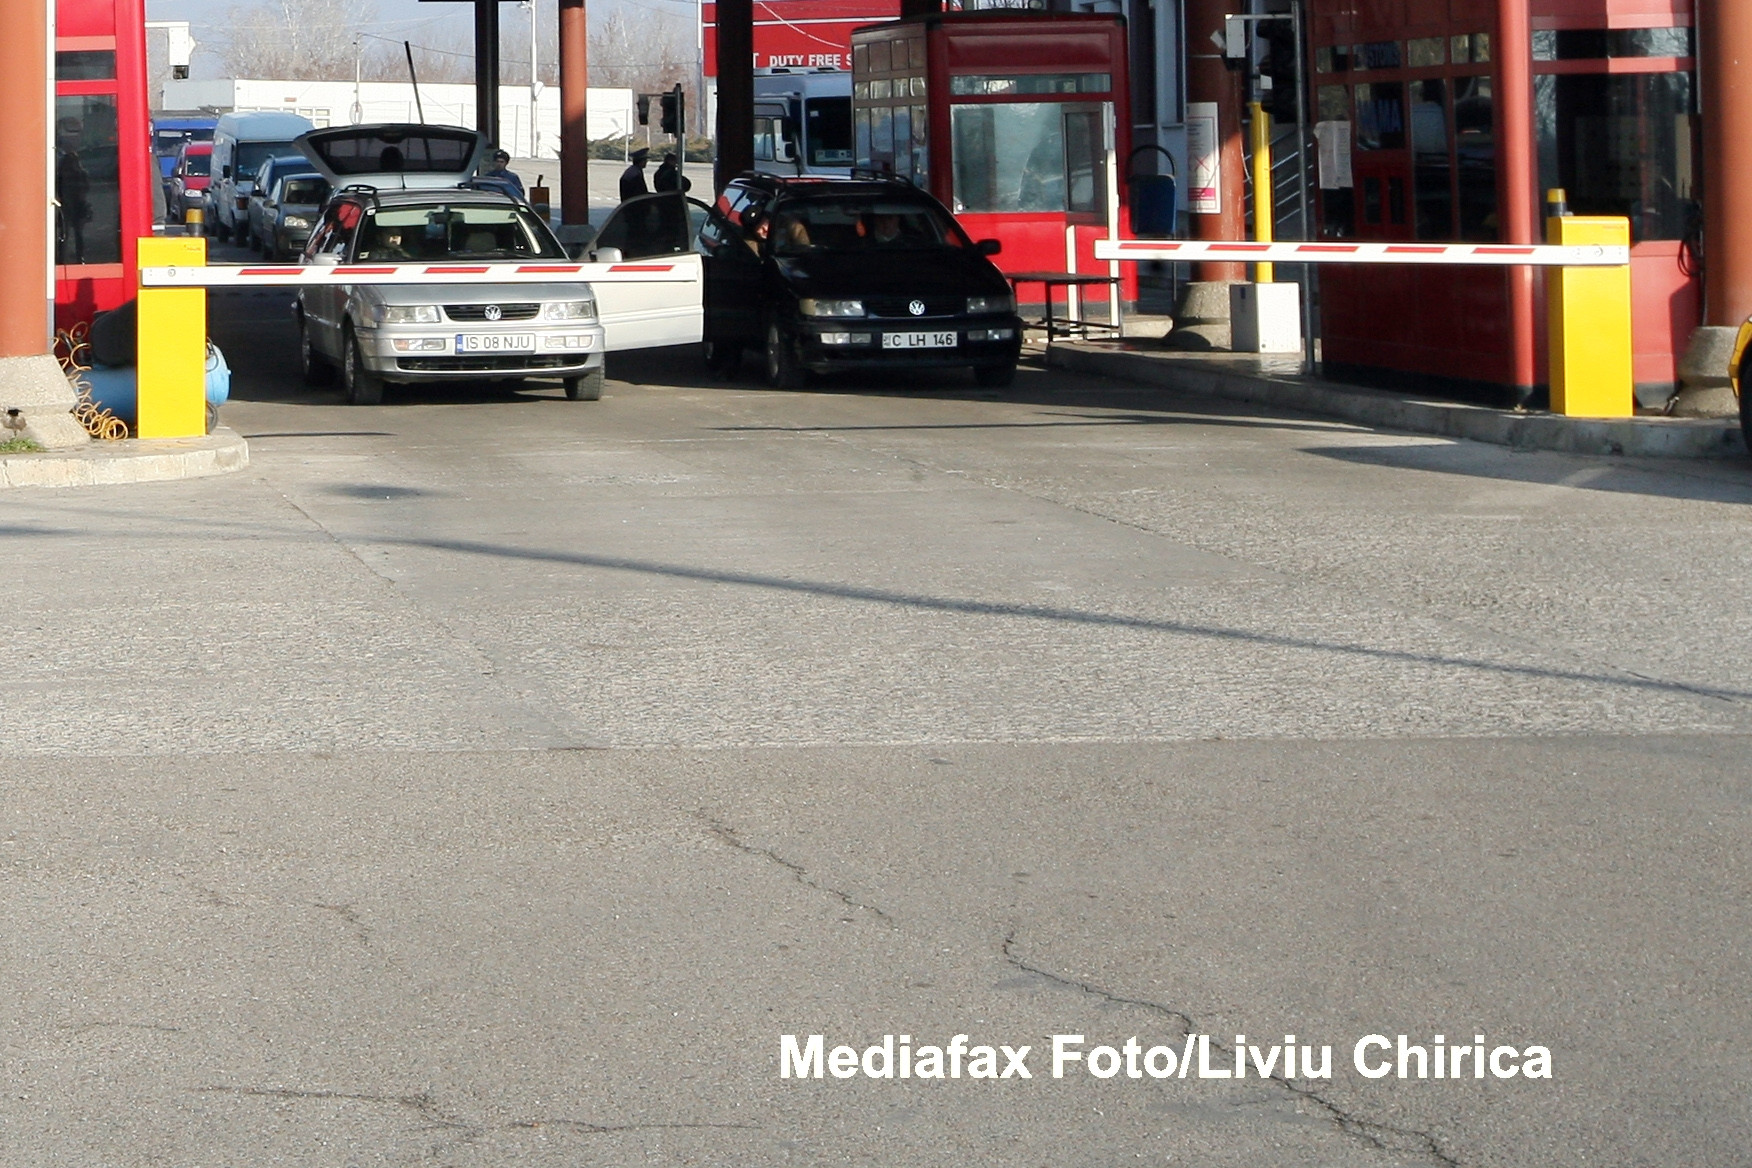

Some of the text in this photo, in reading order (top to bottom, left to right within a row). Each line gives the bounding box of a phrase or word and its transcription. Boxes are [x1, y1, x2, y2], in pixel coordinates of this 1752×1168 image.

[769, 54, 804, 67] DUTY
[808, 53, 841, 66] FREE
[466, 336, 530, 349] IS 08 NJU
[892, 333, 953, 347] C LH 146
